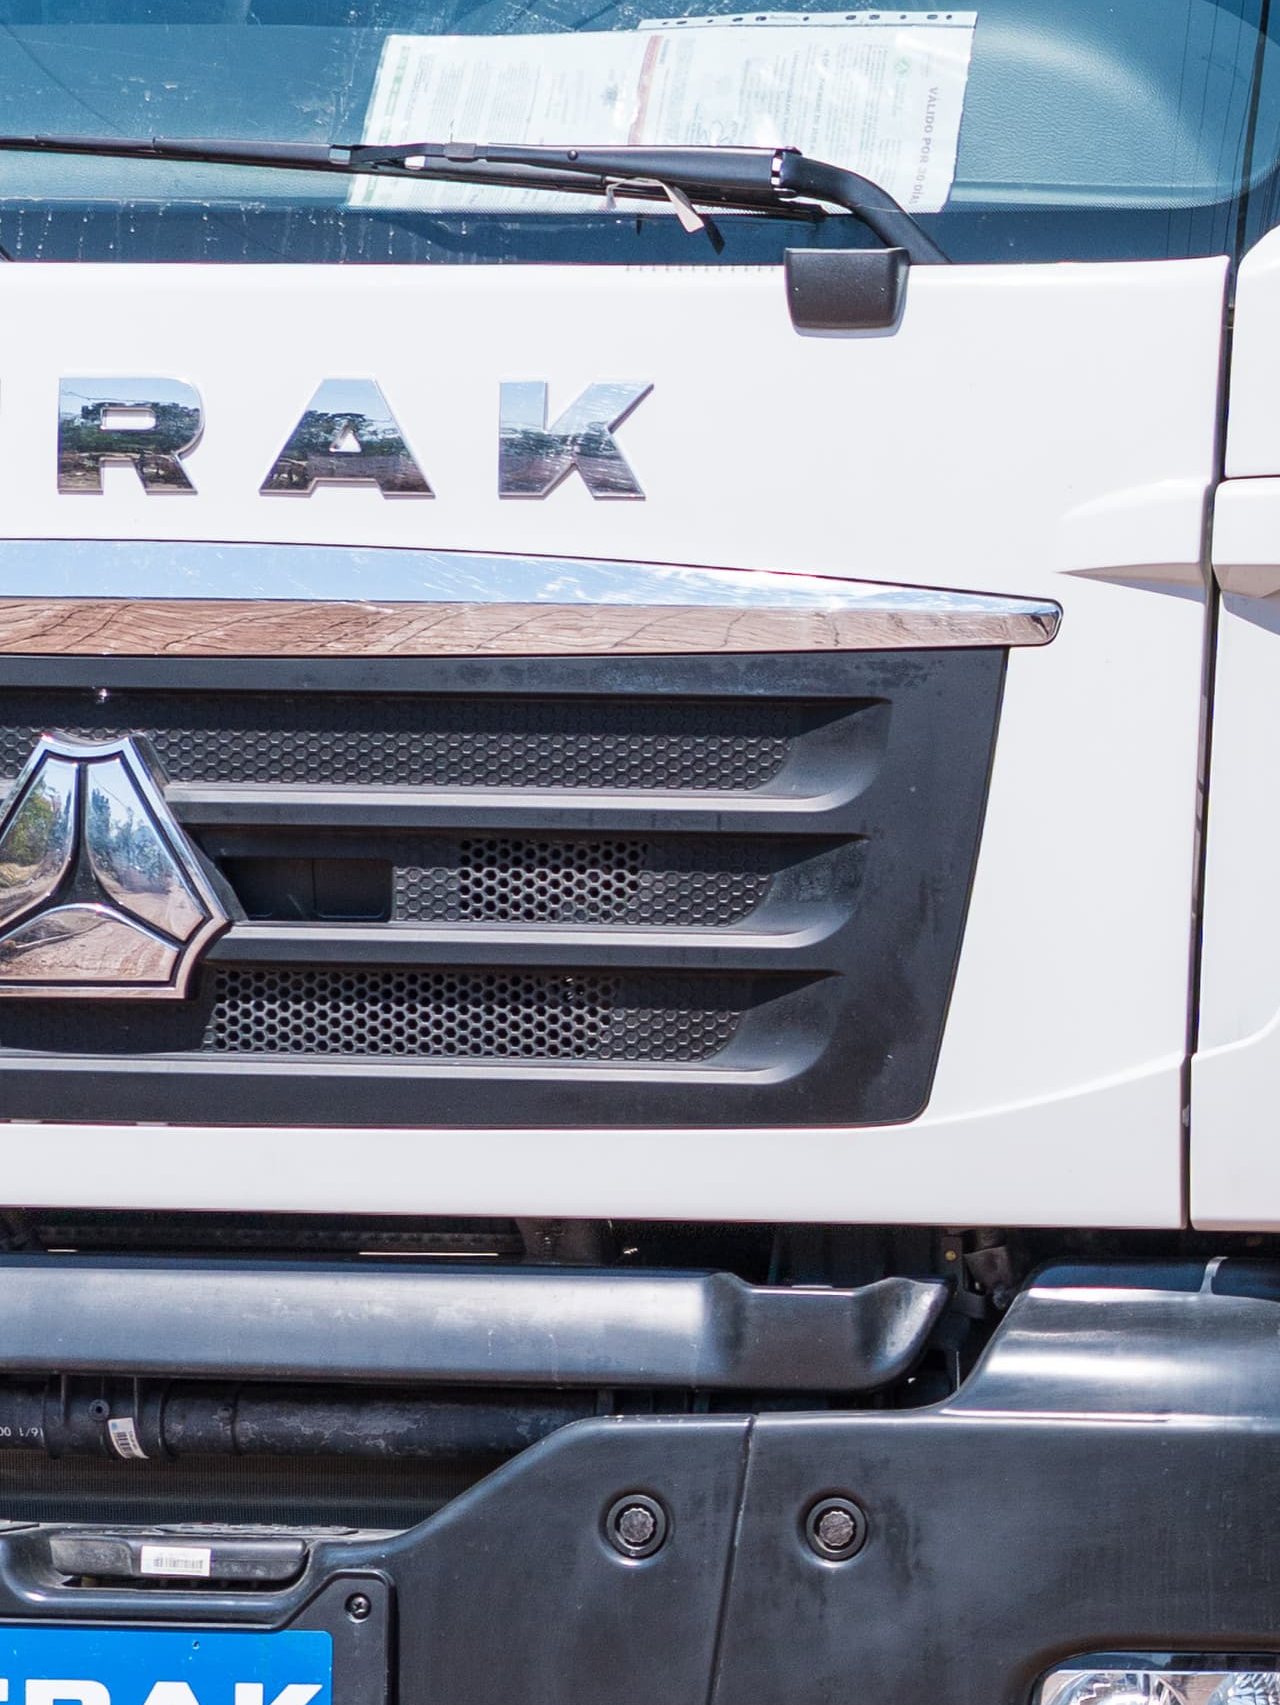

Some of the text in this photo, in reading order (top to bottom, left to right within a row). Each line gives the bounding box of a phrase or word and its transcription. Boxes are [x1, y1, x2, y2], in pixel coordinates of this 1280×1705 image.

[924, 86, 940, 134] VÁLIDO
[919, 137, 932, 164] POR
[0, 376, 655, 501] RAK
